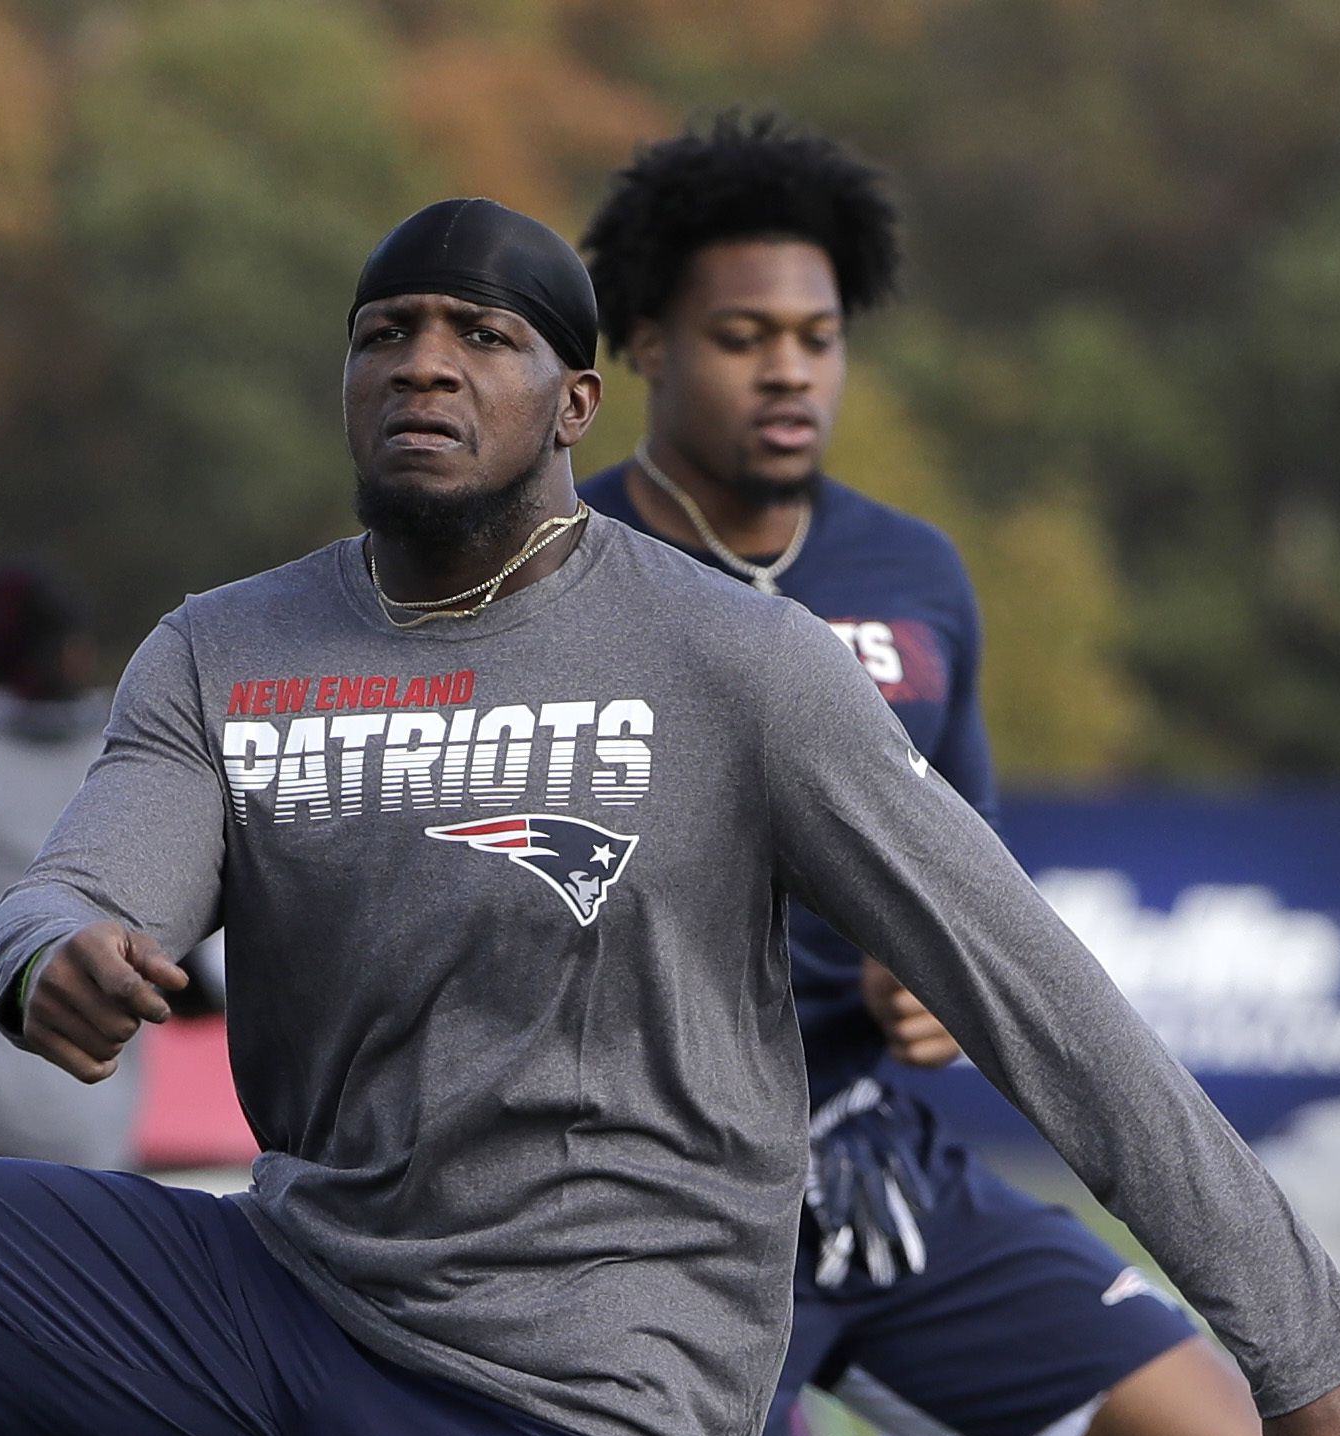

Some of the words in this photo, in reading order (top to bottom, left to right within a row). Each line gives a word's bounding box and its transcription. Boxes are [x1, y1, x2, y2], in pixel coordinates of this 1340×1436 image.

[227, 677, 310, 716] NEW
[315, 668, 476, 711] ENGLAND
[222, 699, 654, 826] PATRIOTS
